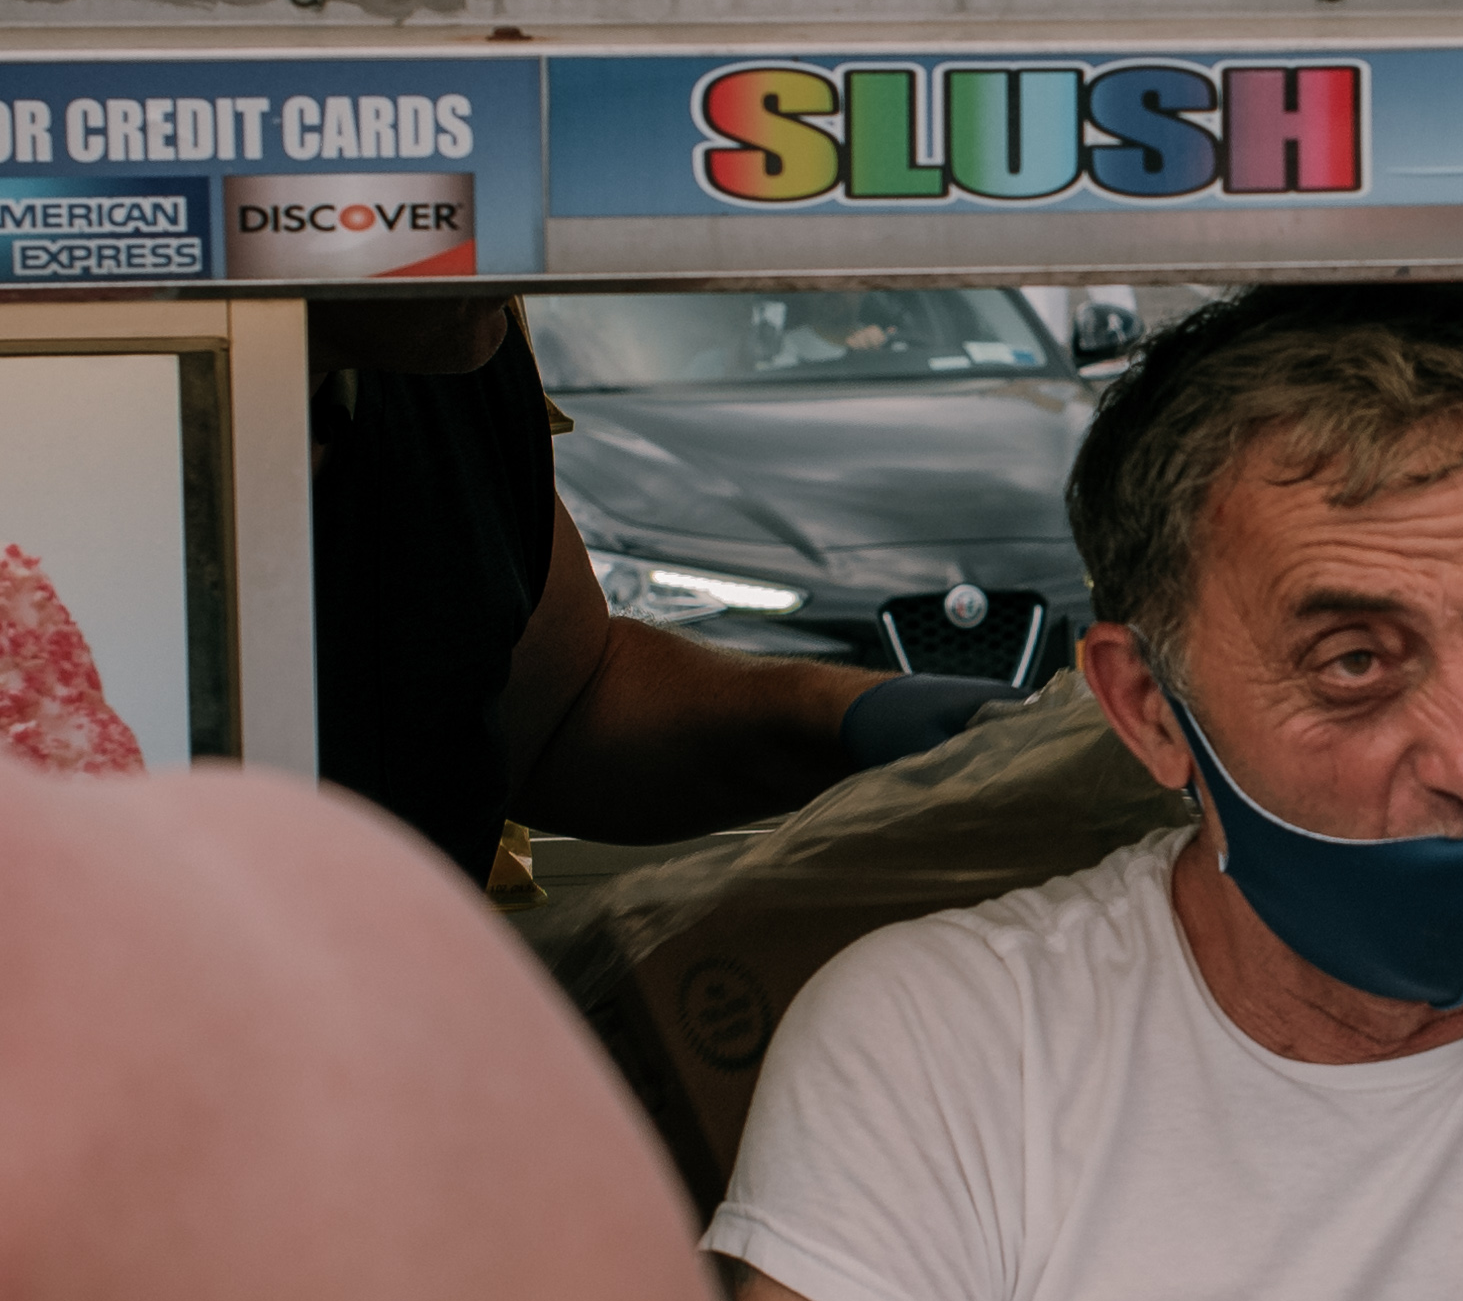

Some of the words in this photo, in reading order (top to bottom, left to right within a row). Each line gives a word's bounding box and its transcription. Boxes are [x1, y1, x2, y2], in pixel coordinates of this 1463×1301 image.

[65, 97, 270, 163] CREDIT
[282, 94, 474, 160] CARDS
[697, 61, 1367, 205] SLUSH
[238, 202, 459, 234] DISCOVER
[13, 238, 202, 276] EXPRESS
